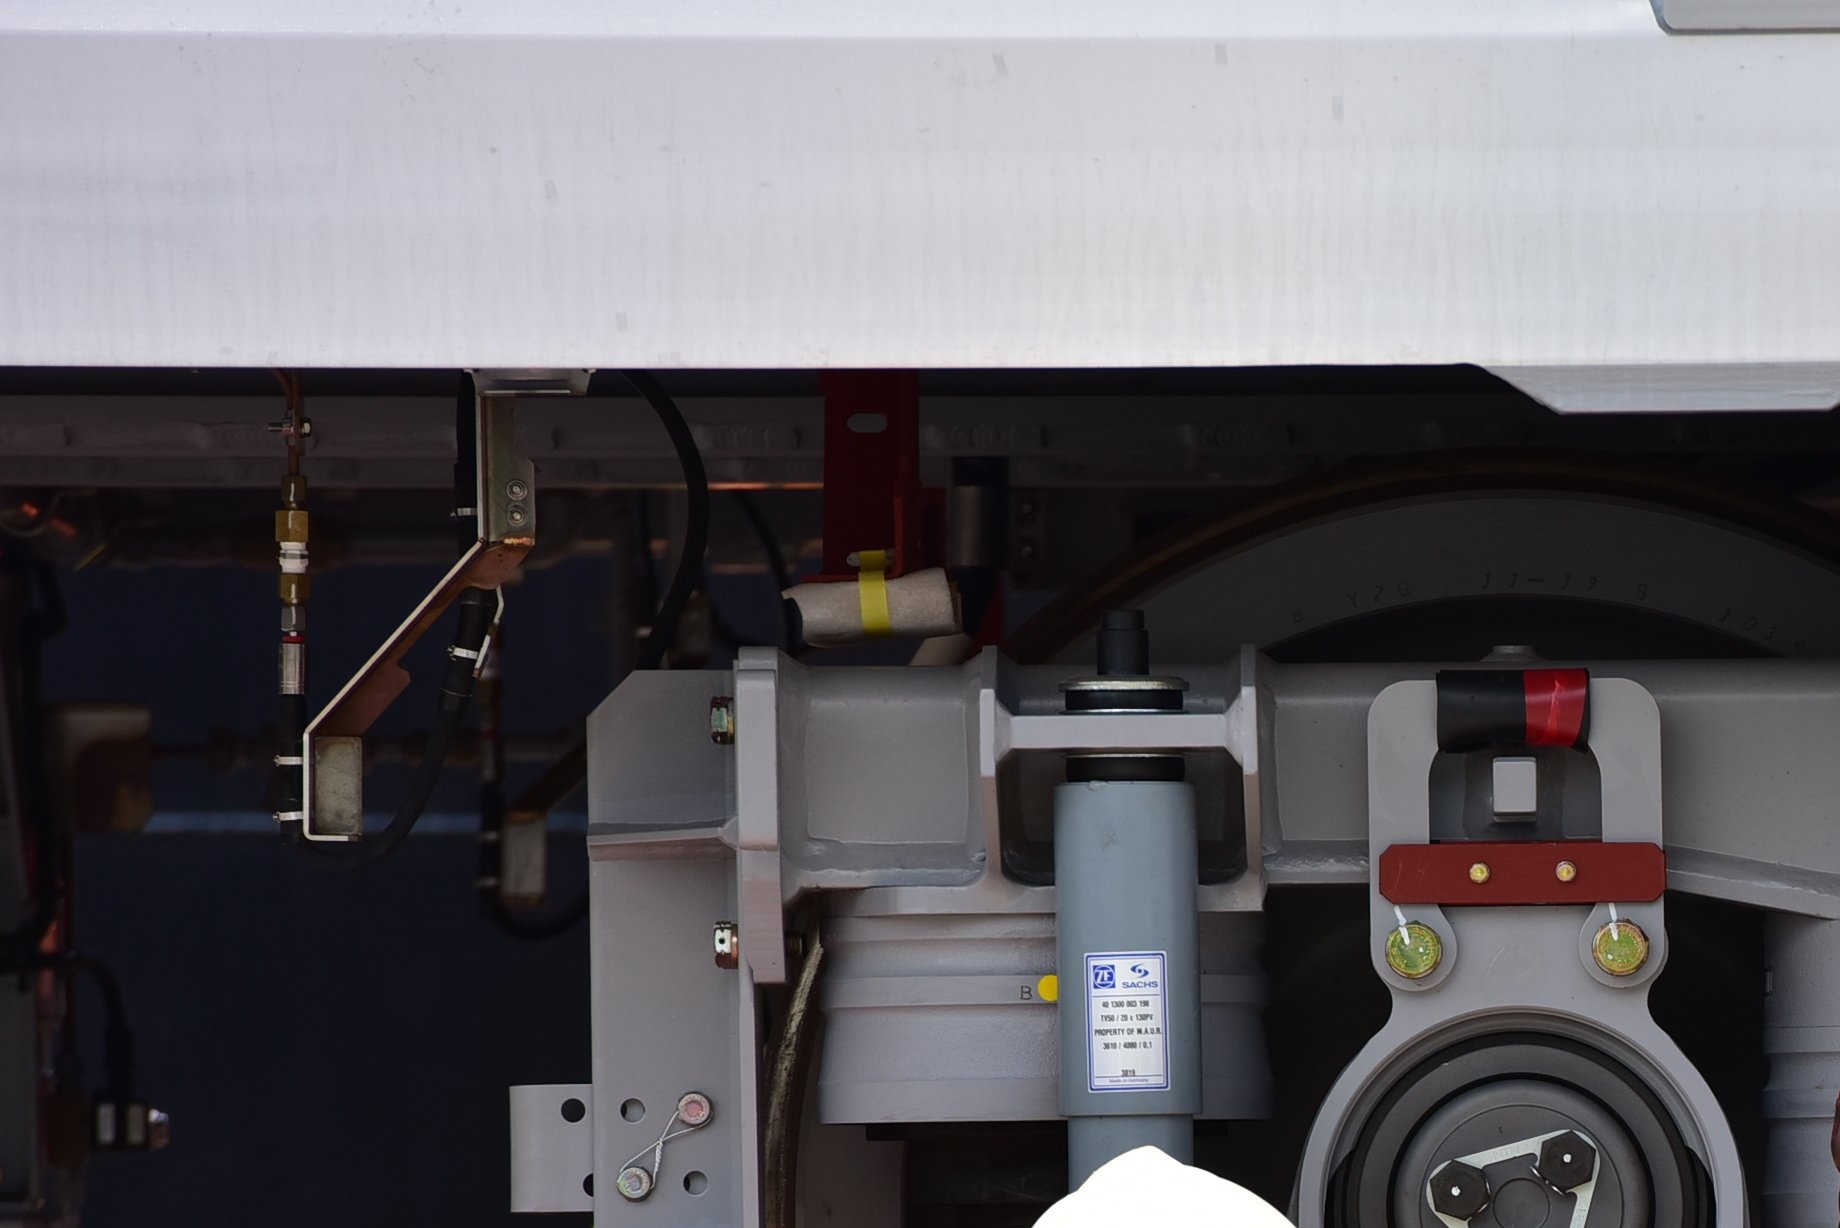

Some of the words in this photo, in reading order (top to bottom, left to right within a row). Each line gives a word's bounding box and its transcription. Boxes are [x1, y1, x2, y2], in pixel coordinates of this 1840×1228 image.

[1121, 980, 1159, 989] SACHS
[1020, 985, 1033, 1000] B
[1094, 1028, 1126, 1036] PROPERTY
[1126, 1027, 1135, 1036] OF
